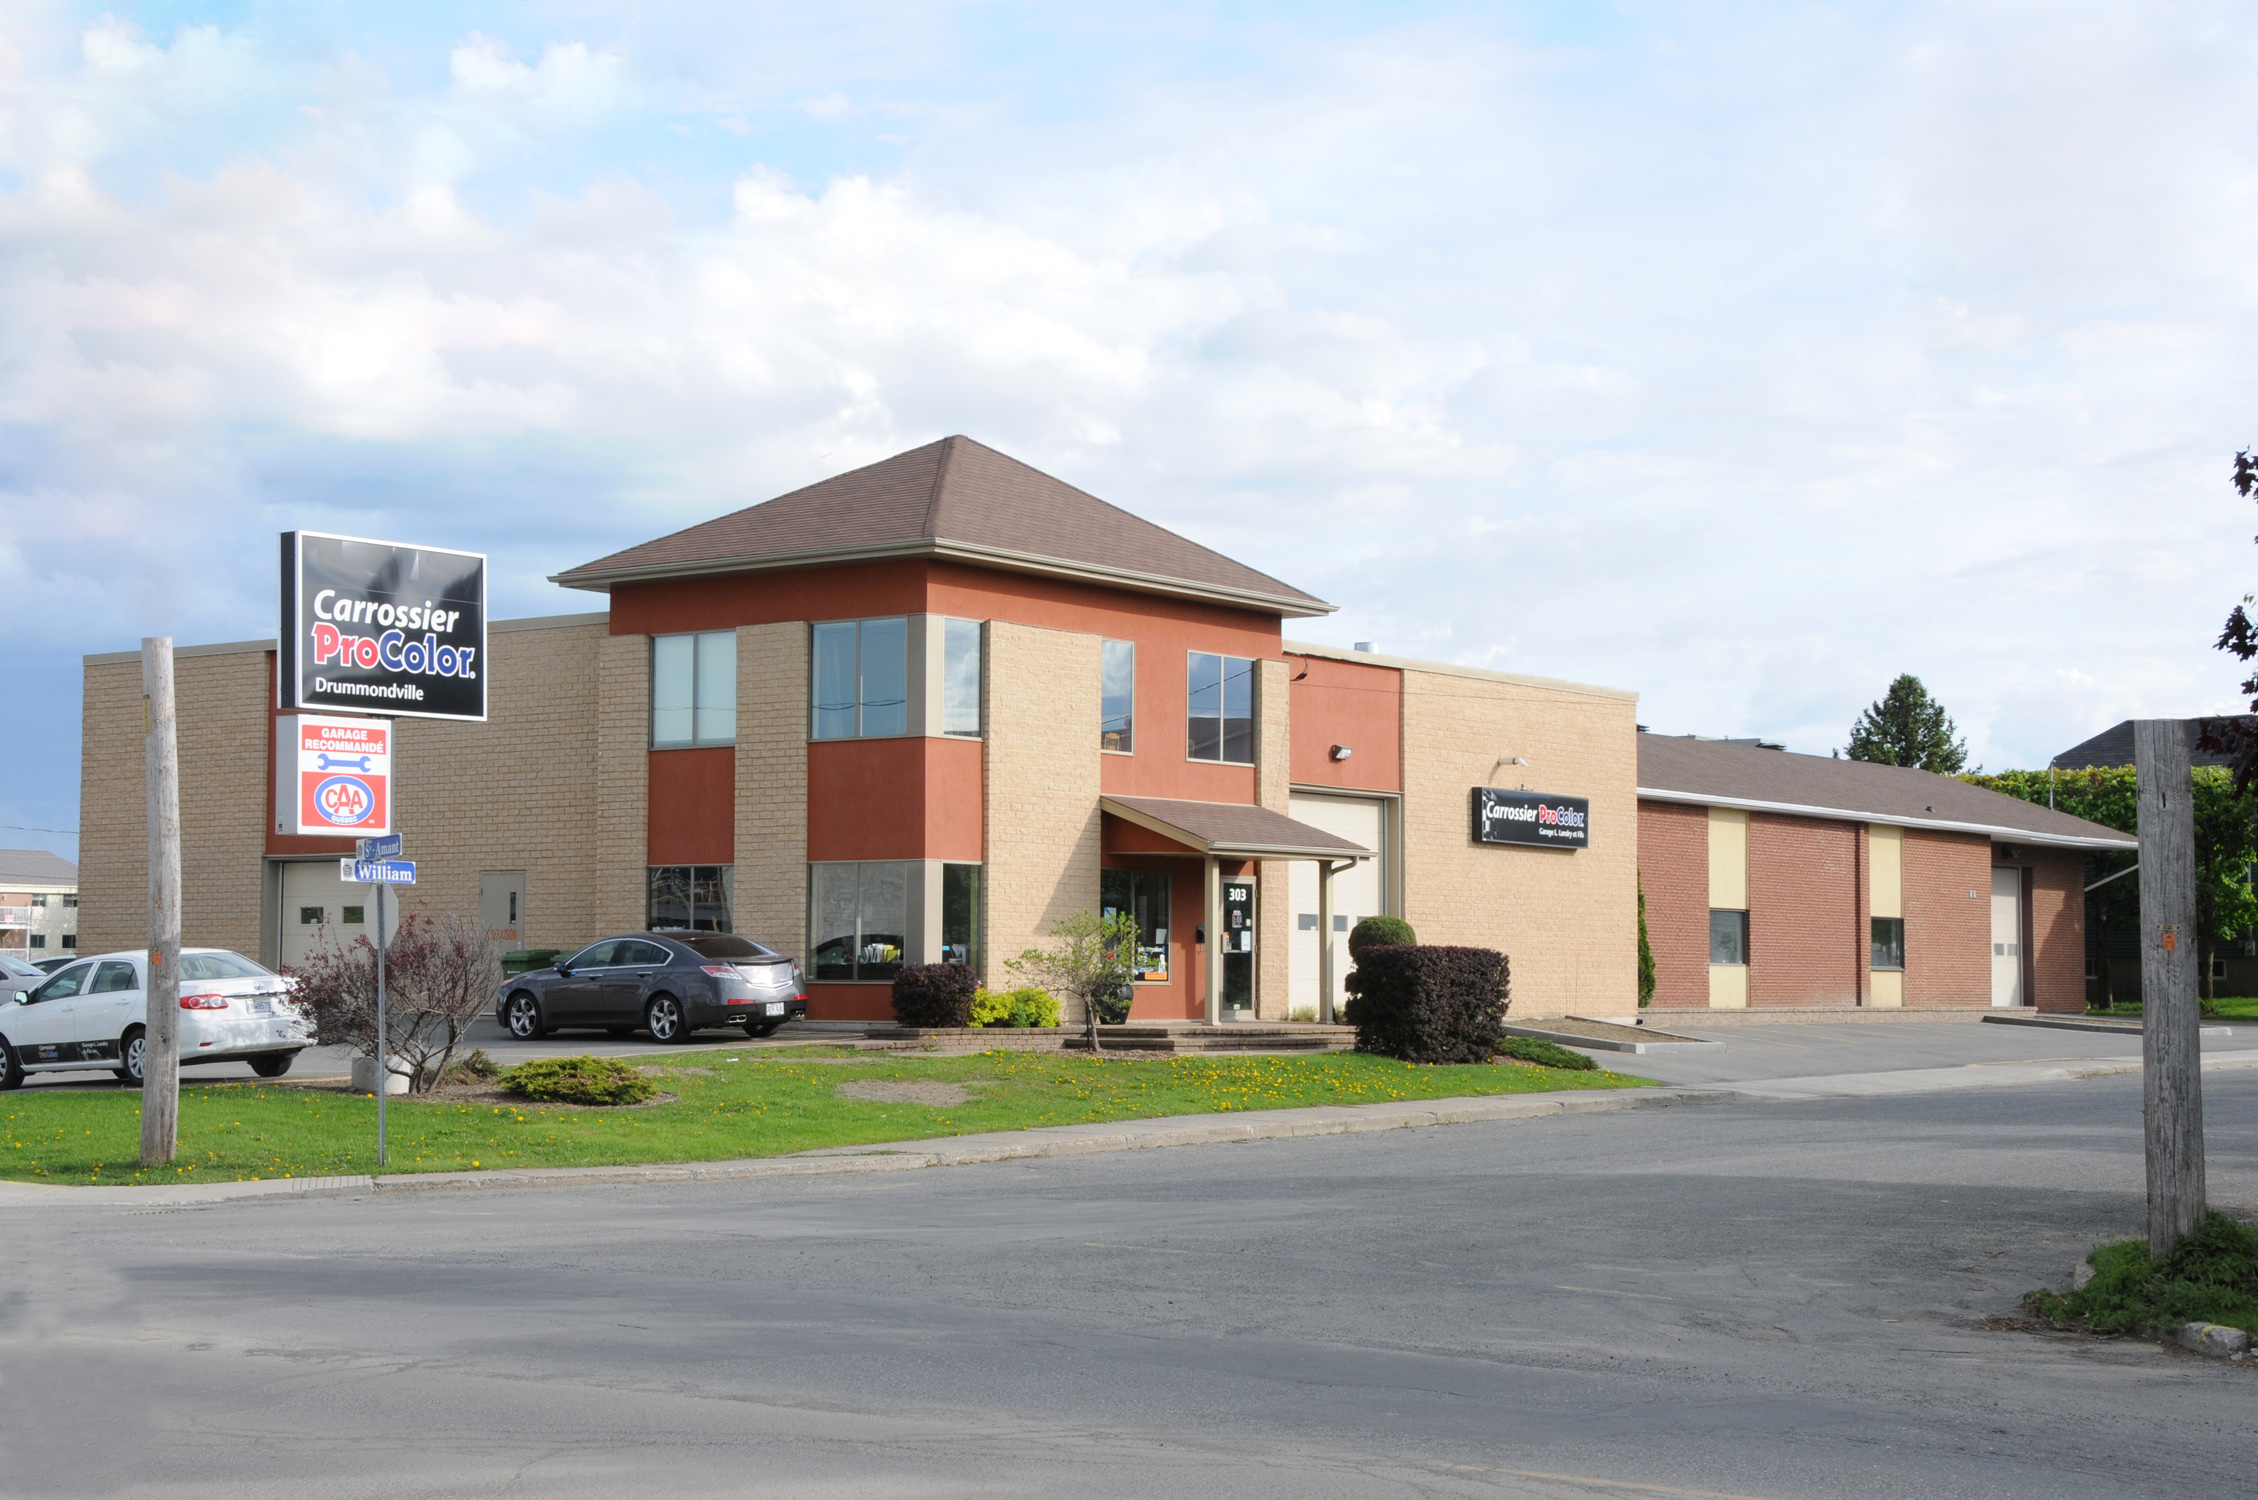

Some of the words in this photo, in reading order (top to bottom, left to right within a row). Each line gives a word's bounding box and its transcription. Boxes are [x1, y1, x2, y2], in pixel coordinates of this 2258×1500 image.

[314, 589, 459, 633] Carrossier
[311, 621, 475, 678] ProColor
[315, 676, 424, 700] Drummondville
[321, 728, 367, 740] GARAGE
[305, 739, 383, 753] RECOMMANDÉ
[325, 785, 363, 814] CAA
[1486, 801, 1537, 822] Carrossier
[1539, 804, 1584, 827] ProColor
[1539, 828, 1553, 837] Garage
[1558, 829, 1572, 839] Landry
[357, 864, 413, 881] William
[1228, 887, 1247, 901] 303
